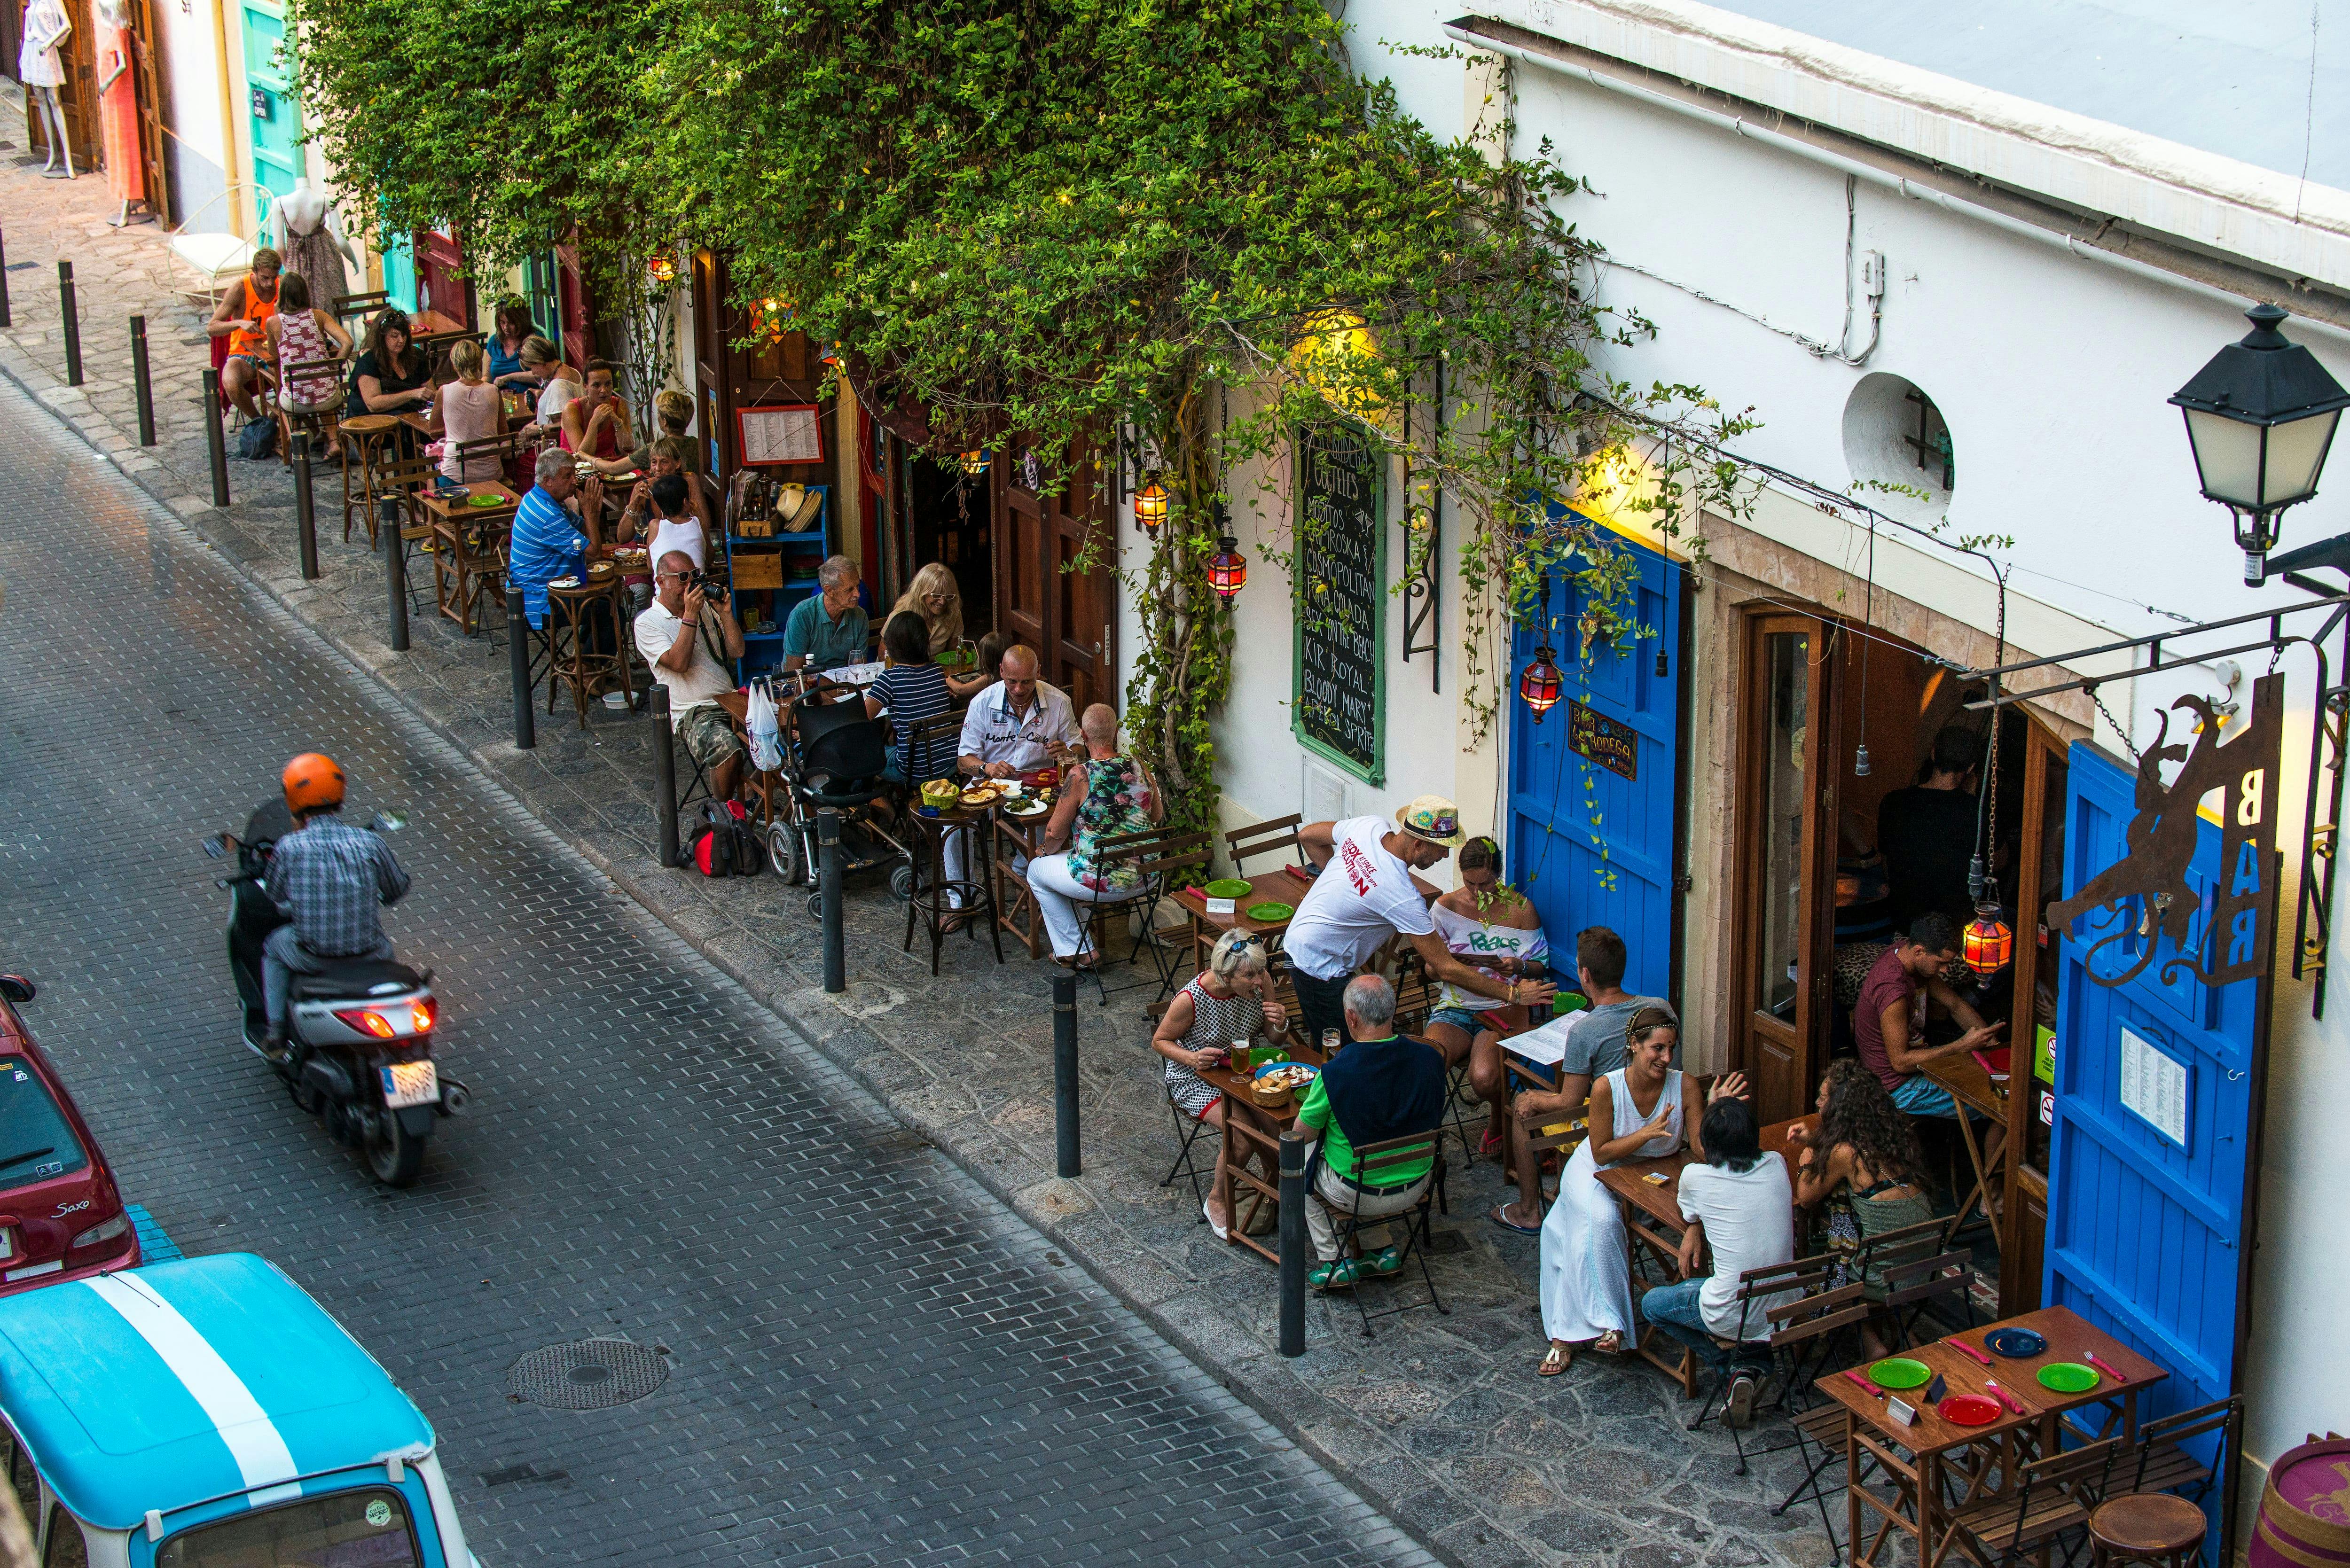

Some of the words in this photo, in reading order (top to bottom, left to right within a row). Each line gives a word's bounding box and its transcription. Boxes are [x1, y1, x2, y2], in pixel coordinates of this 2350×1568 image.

[254, 106, 266, 117] OPEN
[1308, 497, 1344, 530] MOJITOS
[1308, 519, 1361, 562] AIPIROSKA
[1307, 548, 1375, 603] COSMOPOLITAN
[1334, 590, 1369, 631] COLADA
[1306, 606, 1323, 636] SEX
[1328, 618, 1338, 642] ON
[1354, 631, 1375, 667] BEACH
[1305, 669, 1338, 708] BLOODY
[1331, 653, 1367, 694] ROYAL
[1590, 734, 1630, 760] BODEGA
[1362, 868, 1371, 880] FROM
[1368, 878, 1378, 888] 9PM
[1363, 859, 1377, 874] SPACE
[1467, 931, 1522, 952] Peace
[51, 1200, 90, 1218] Saxo
